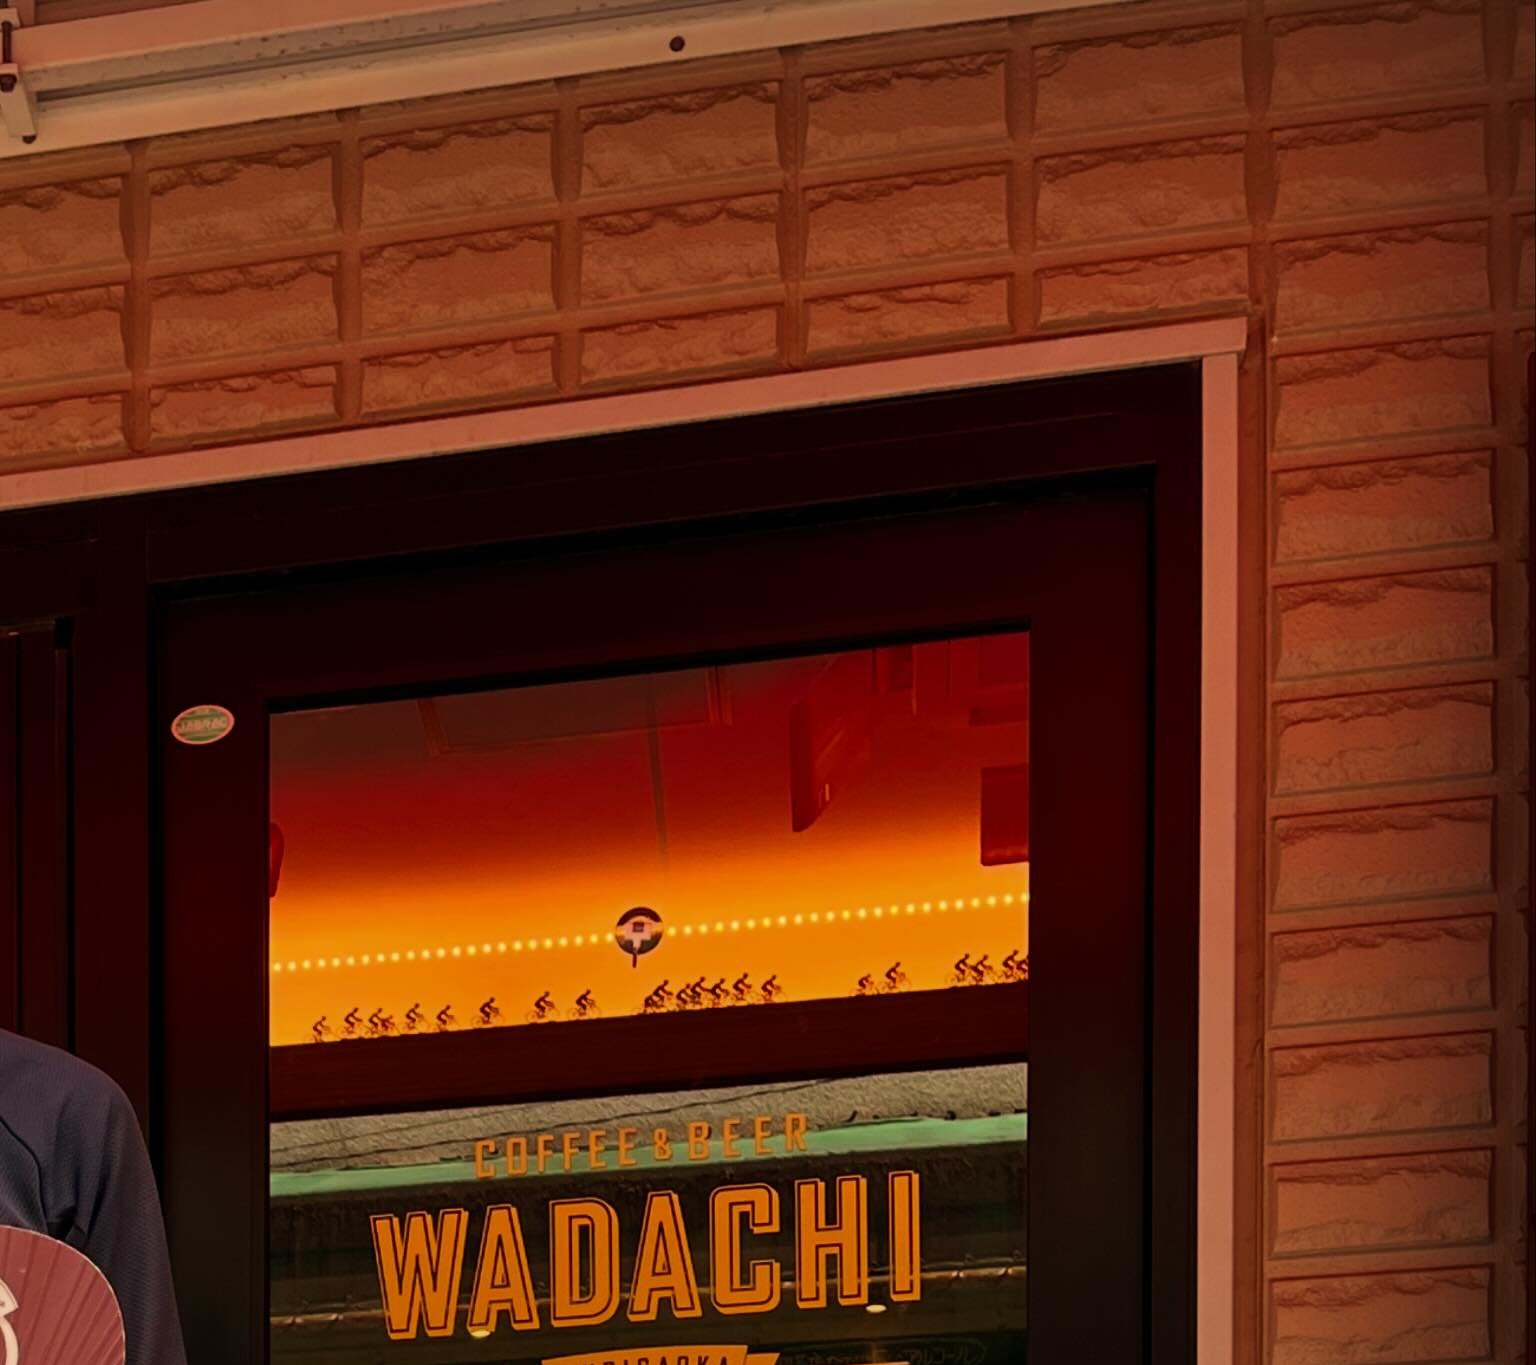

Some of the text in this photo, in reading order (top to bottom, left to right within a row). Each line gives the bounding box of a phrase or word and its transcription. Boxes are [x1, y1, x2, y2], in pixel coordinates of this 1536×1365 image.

[474, 1127, 637, 1180] COFFEE
[687, 1112, 808, 1160] BEER
[370, 1170, 921, 1340] WADACHI
